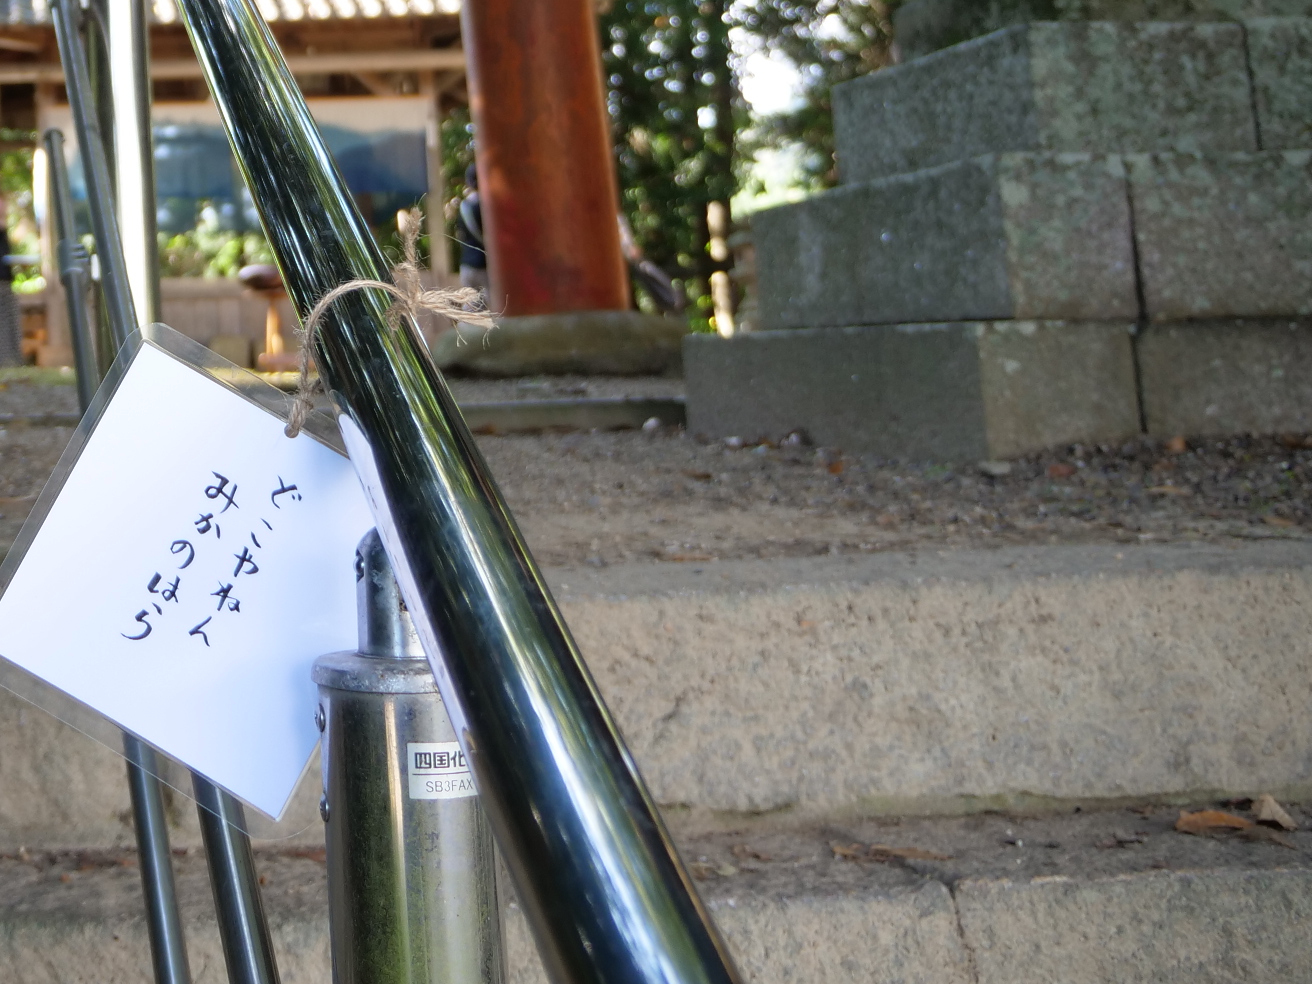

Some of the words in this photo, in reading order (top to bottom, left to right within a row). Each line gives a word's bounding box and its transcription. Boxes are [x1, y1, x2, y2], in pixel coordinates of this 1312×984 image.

[120, 471, 239, 641] みかのはら
[189, 475, 302, 647] どこやねん
